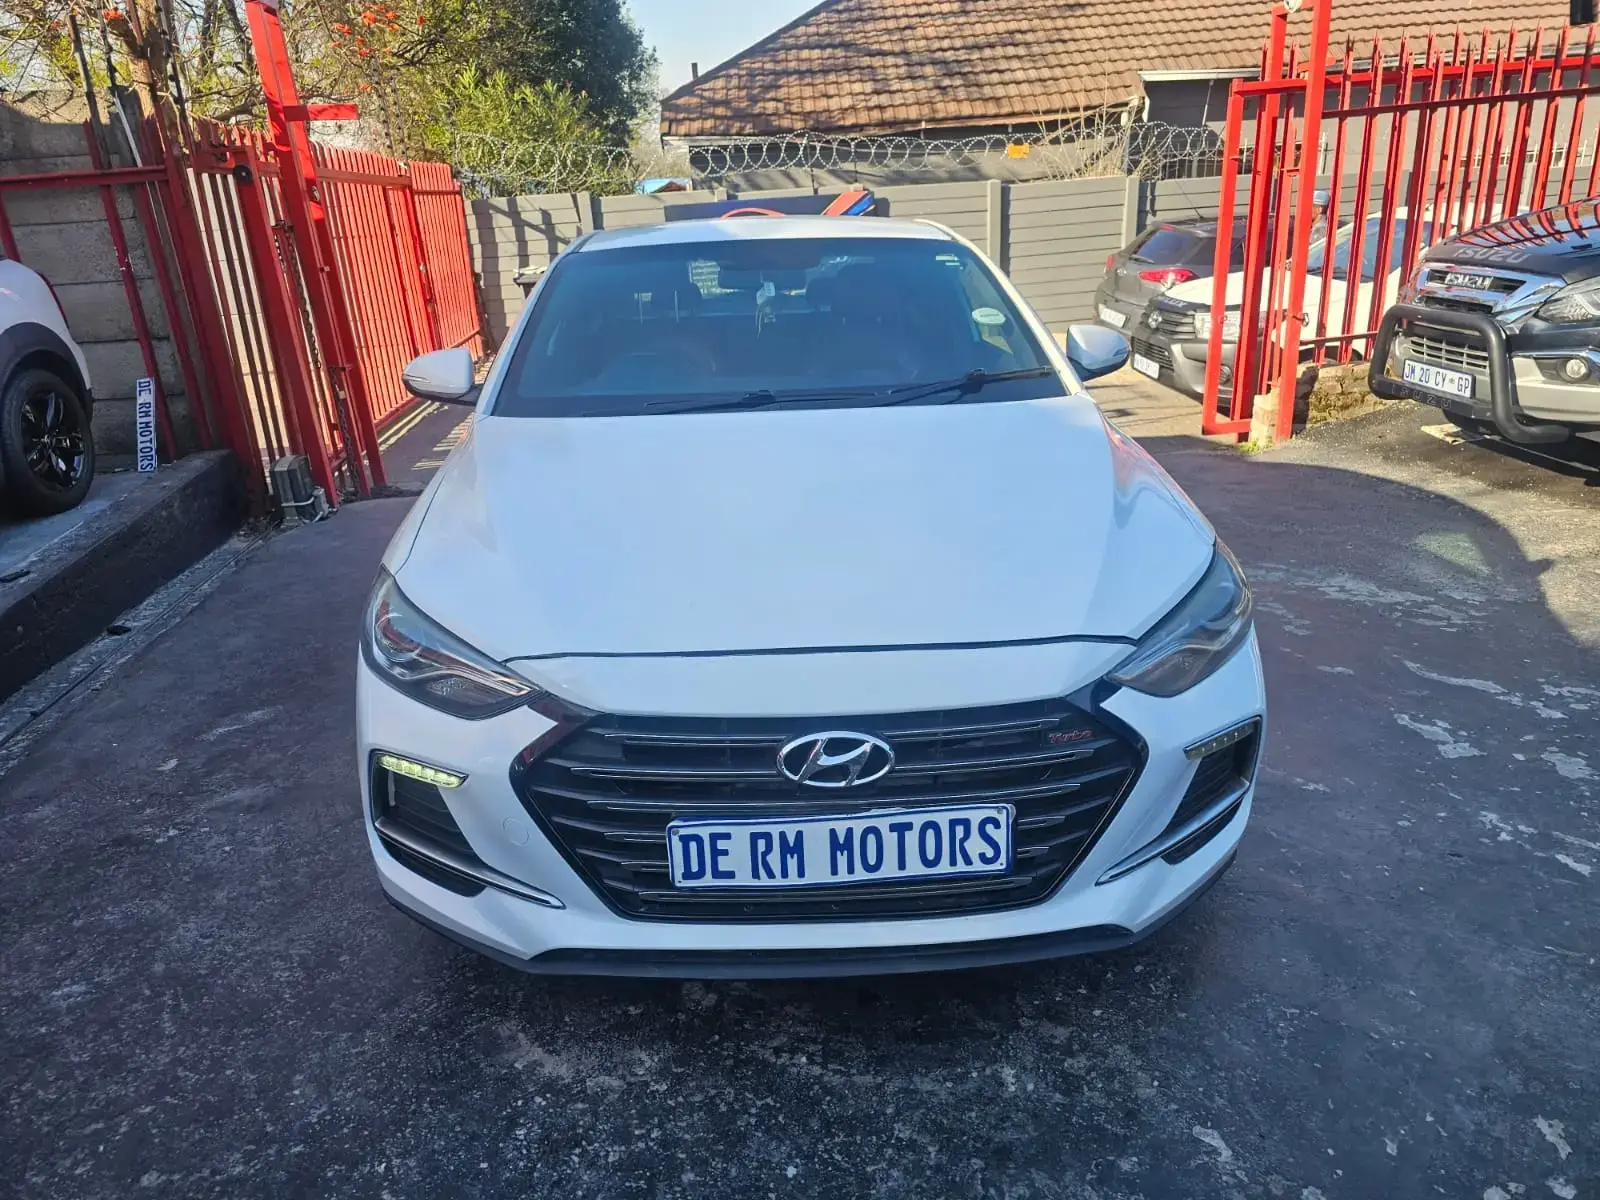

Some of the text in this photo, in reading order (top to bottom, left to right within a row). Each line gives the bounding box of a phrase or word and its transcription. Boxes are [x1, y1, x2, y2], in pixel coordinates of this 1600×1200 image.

[1452, 247, 1532, 264] ISUZU
[1444, 272, 1494, 290] ISUZU
[1405, 363, 1470, 394] JM 20 CY GP
[138, 380, 154, 471] DE RM MOTORS
[678, 816, 1002, 881] DE RM MOTORS
